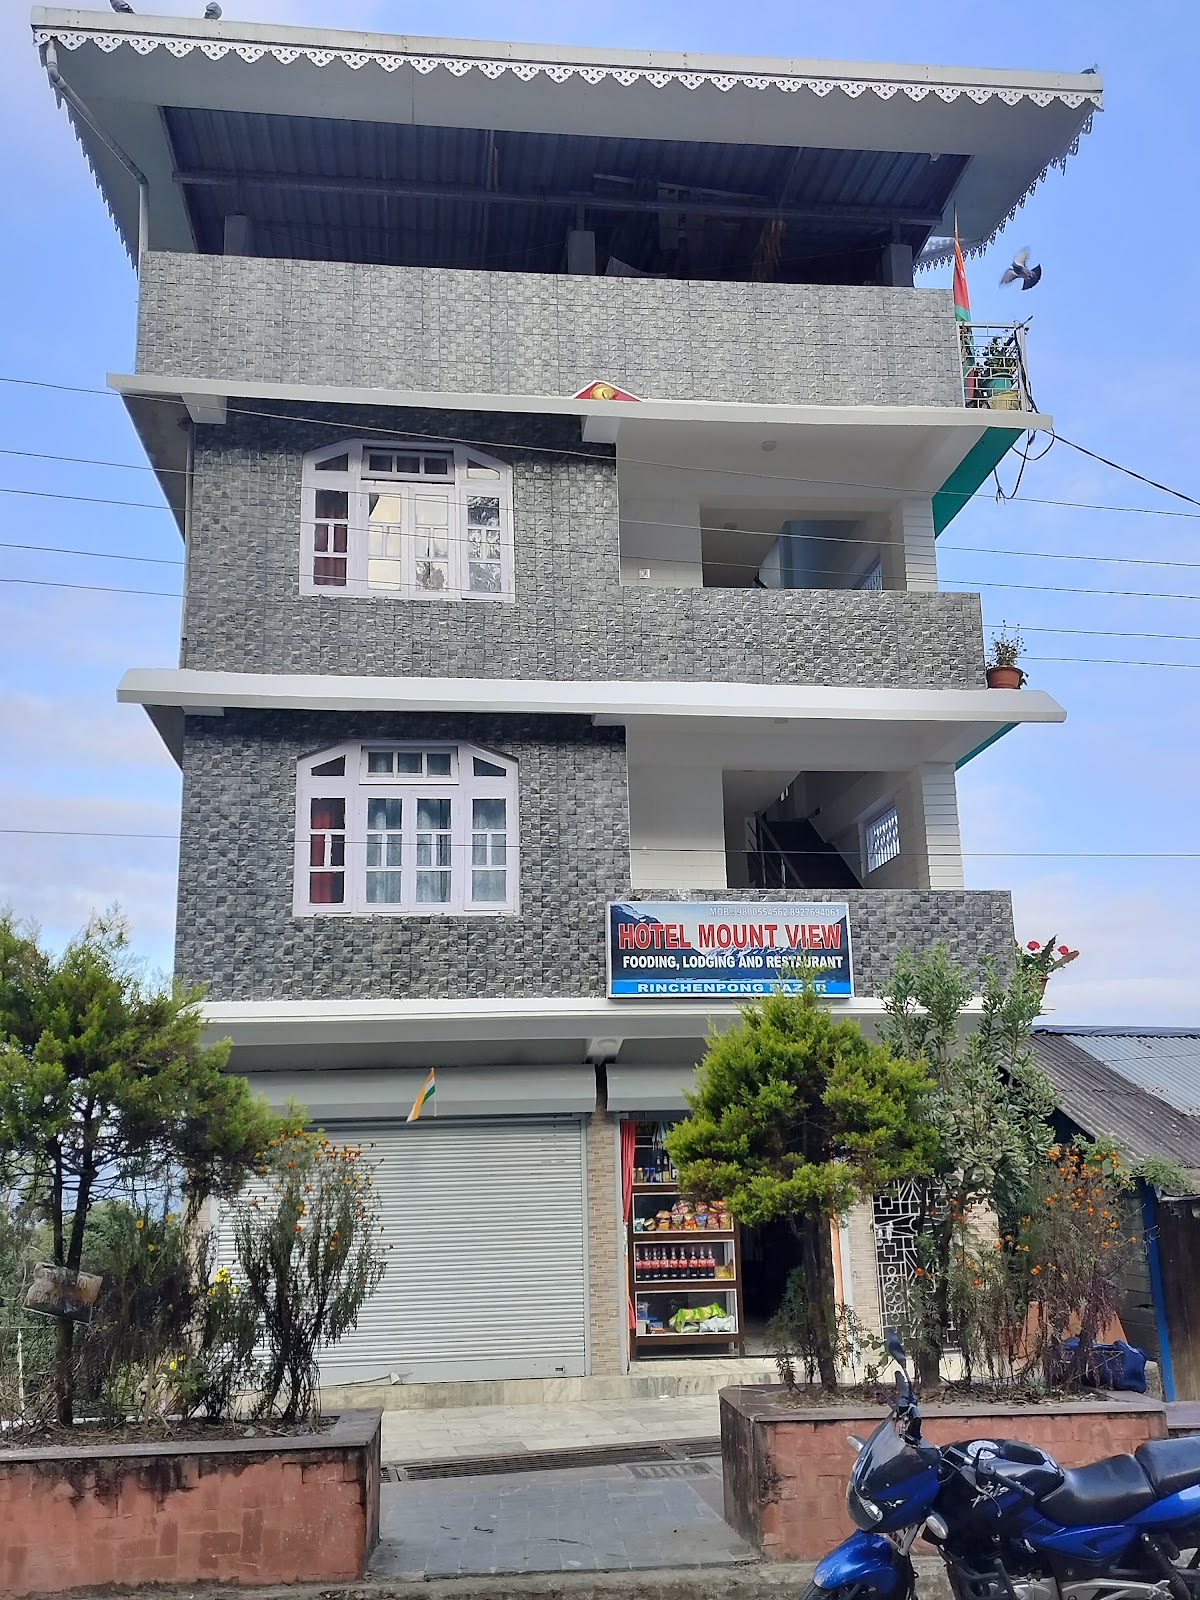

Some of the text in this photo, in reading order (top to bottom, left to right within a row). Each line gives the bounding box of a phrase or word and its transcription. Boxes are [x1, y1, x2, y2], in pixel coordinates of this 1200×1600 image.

[618, 922, 842, 950] HOTEL MOUNT VIEW
[623, 955, 844, 971] FOODING, LODGING AND RESTAURANT
[637, 983, 764, 993] RINCHENPONG
